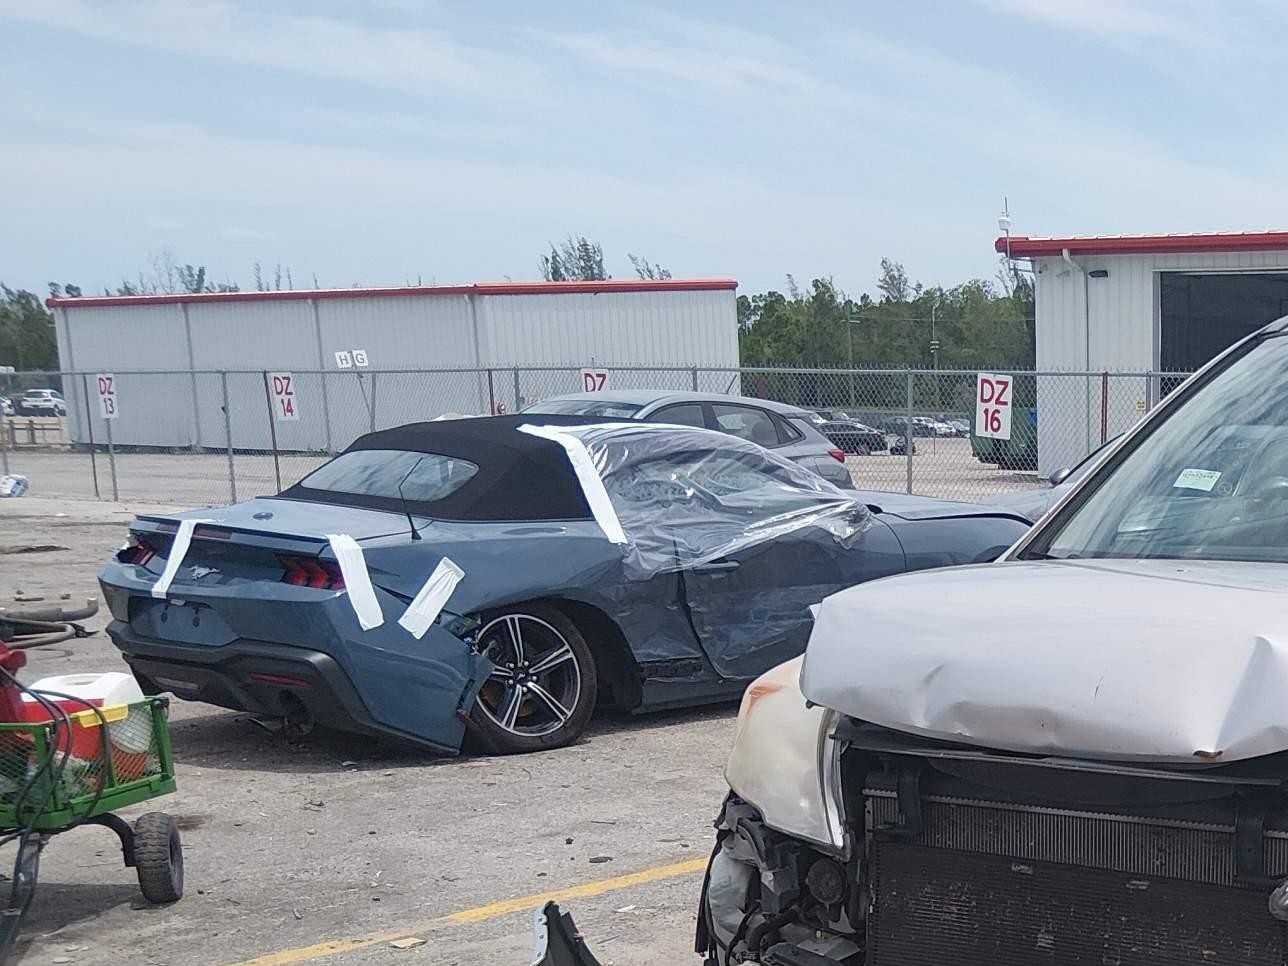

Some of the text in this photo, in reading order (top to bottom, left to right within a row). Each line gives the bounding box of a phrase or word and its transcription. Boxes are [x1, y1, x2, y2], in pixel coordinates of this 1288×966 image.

[339, 353, 365, 366] H G
[98, 377, 114, 395] DZ
[273, 376, 294, 396] DZ
[980, 378, 1009, 406] DZ
[104, 397, 115, 415] 13
[281, 398, 294, 417] 14
[983, 407, 1002, 433] 16
